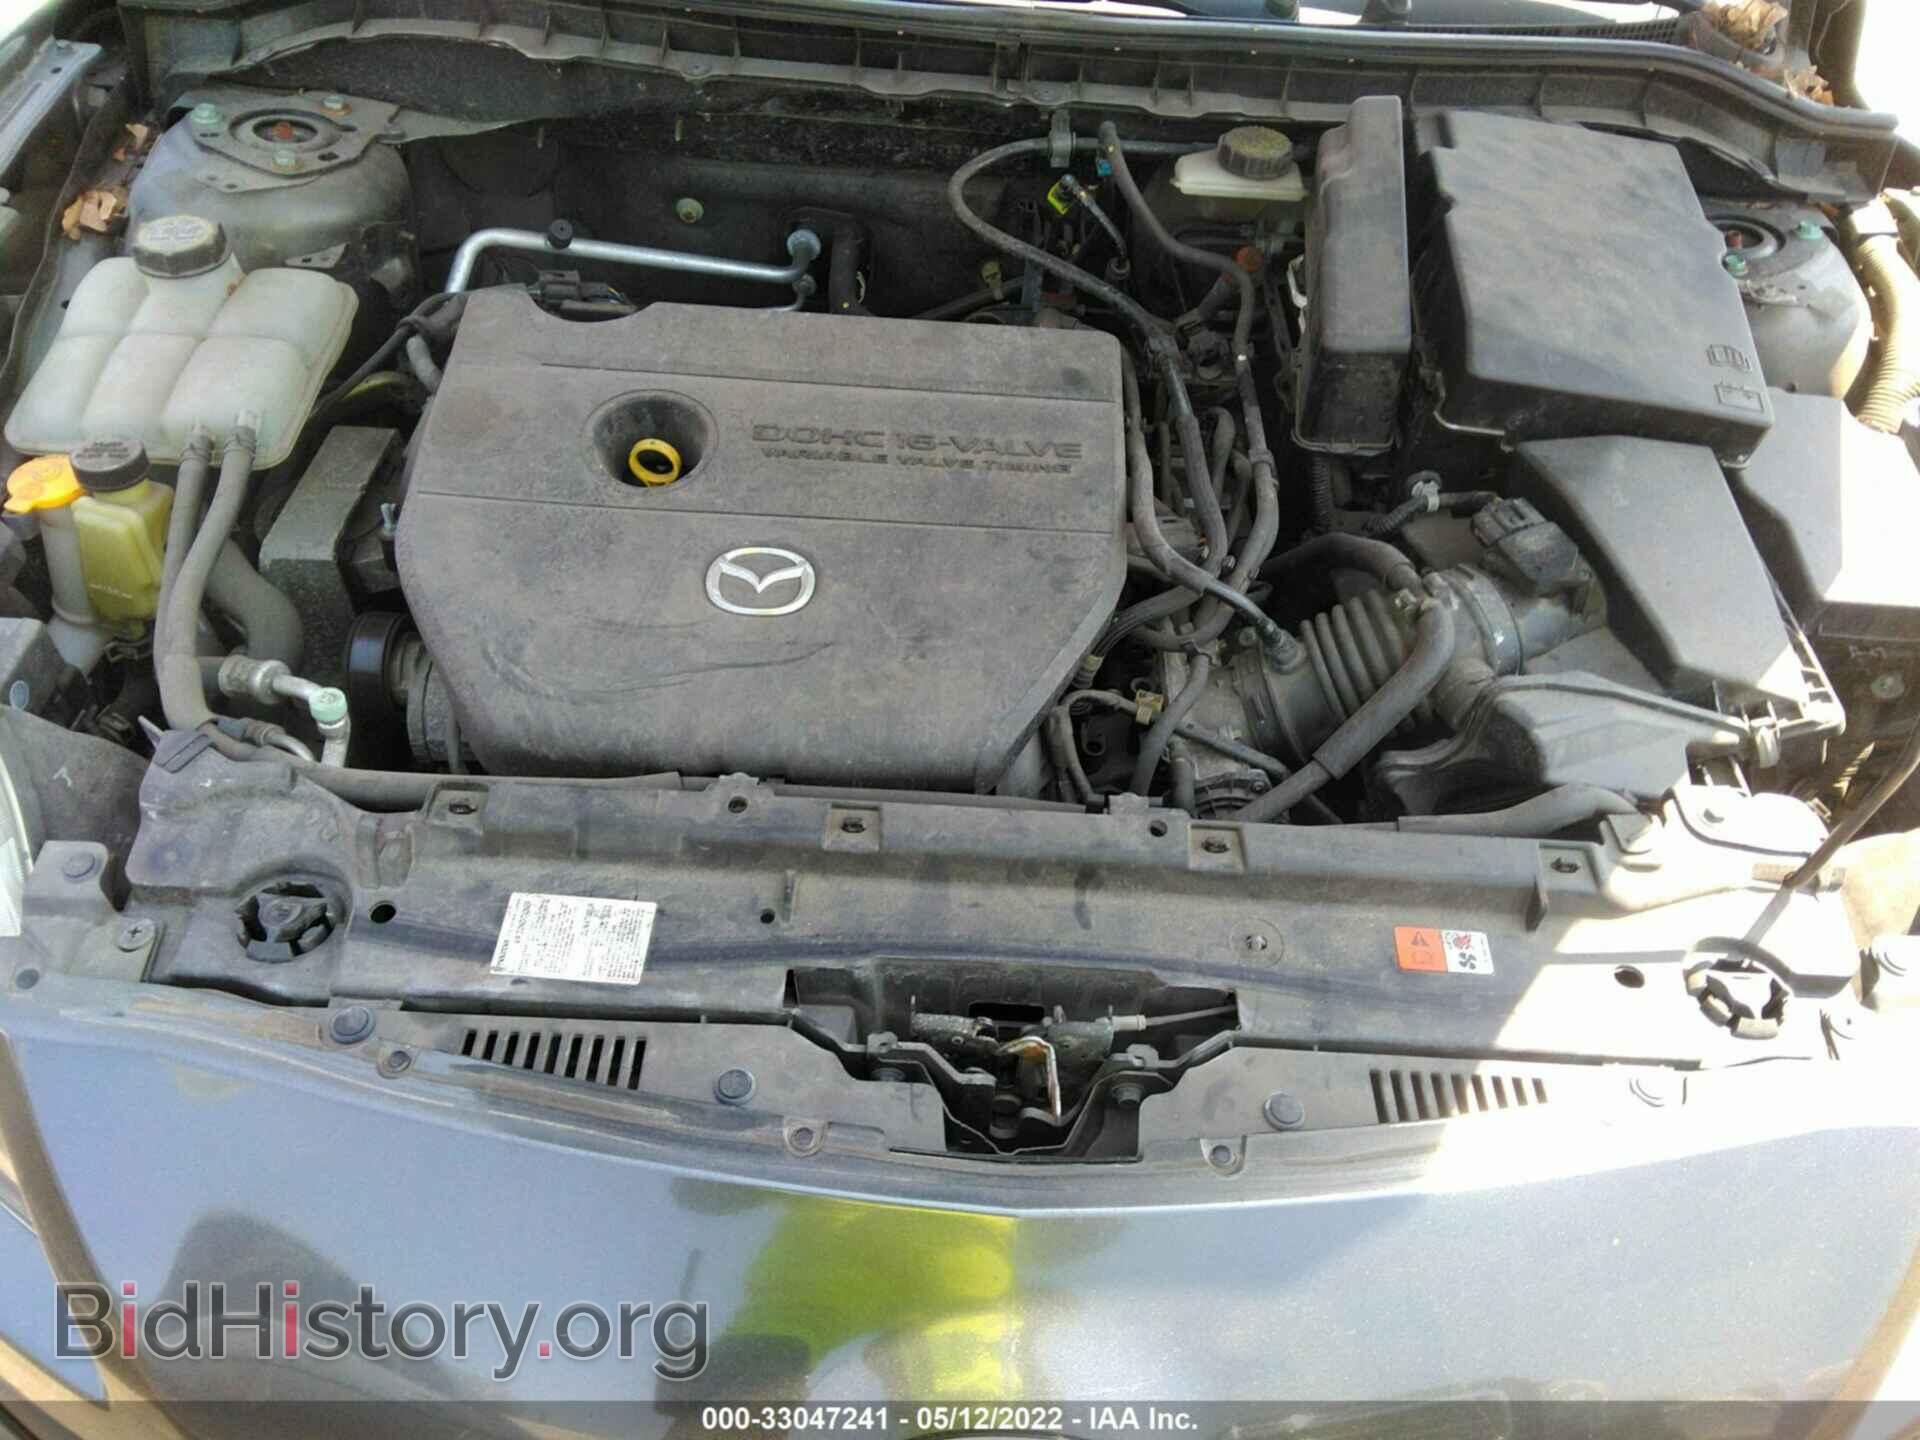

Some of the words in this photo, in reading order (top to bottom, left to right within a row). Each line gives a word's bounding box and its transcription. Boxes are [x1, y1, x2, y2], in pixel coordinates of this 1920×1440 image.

[752, 424, 885, 448] DOHC
[895, 432, 1083, 459] 16-VALVE
[896, 454, 975, 470] VALVE
